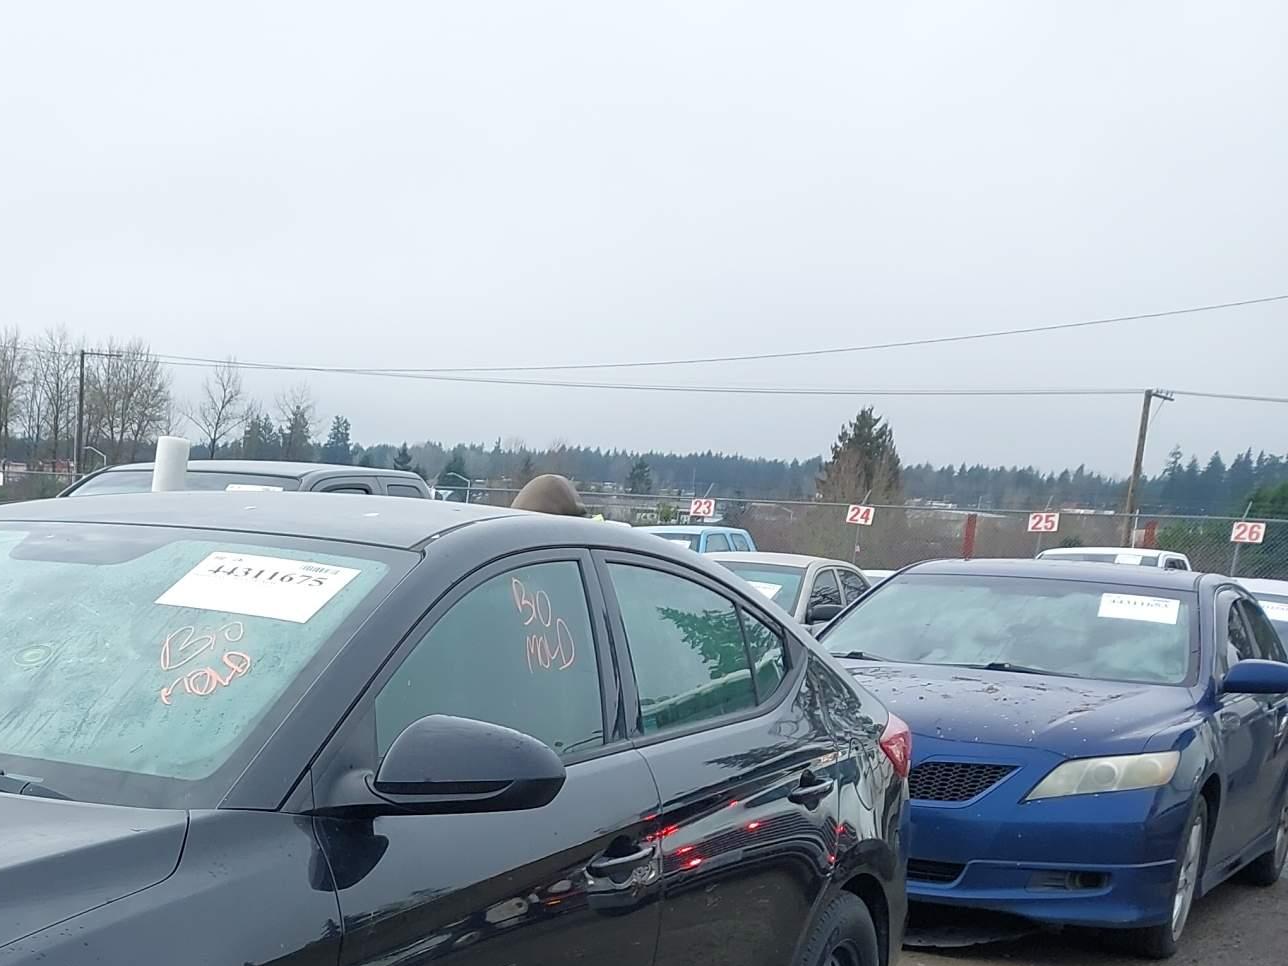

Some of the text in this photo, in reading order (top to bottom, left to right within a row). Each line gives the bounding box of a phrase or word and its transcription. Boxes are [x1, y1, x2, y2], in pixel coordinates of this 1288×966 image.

[692, 500, 712, 515] 23
[849, 506, 871, 523] 24
[1031, 514, 1055, 530] 25
[1234, 523, 1262, 541] 26
[208, 565, 328, 587] 44311675
